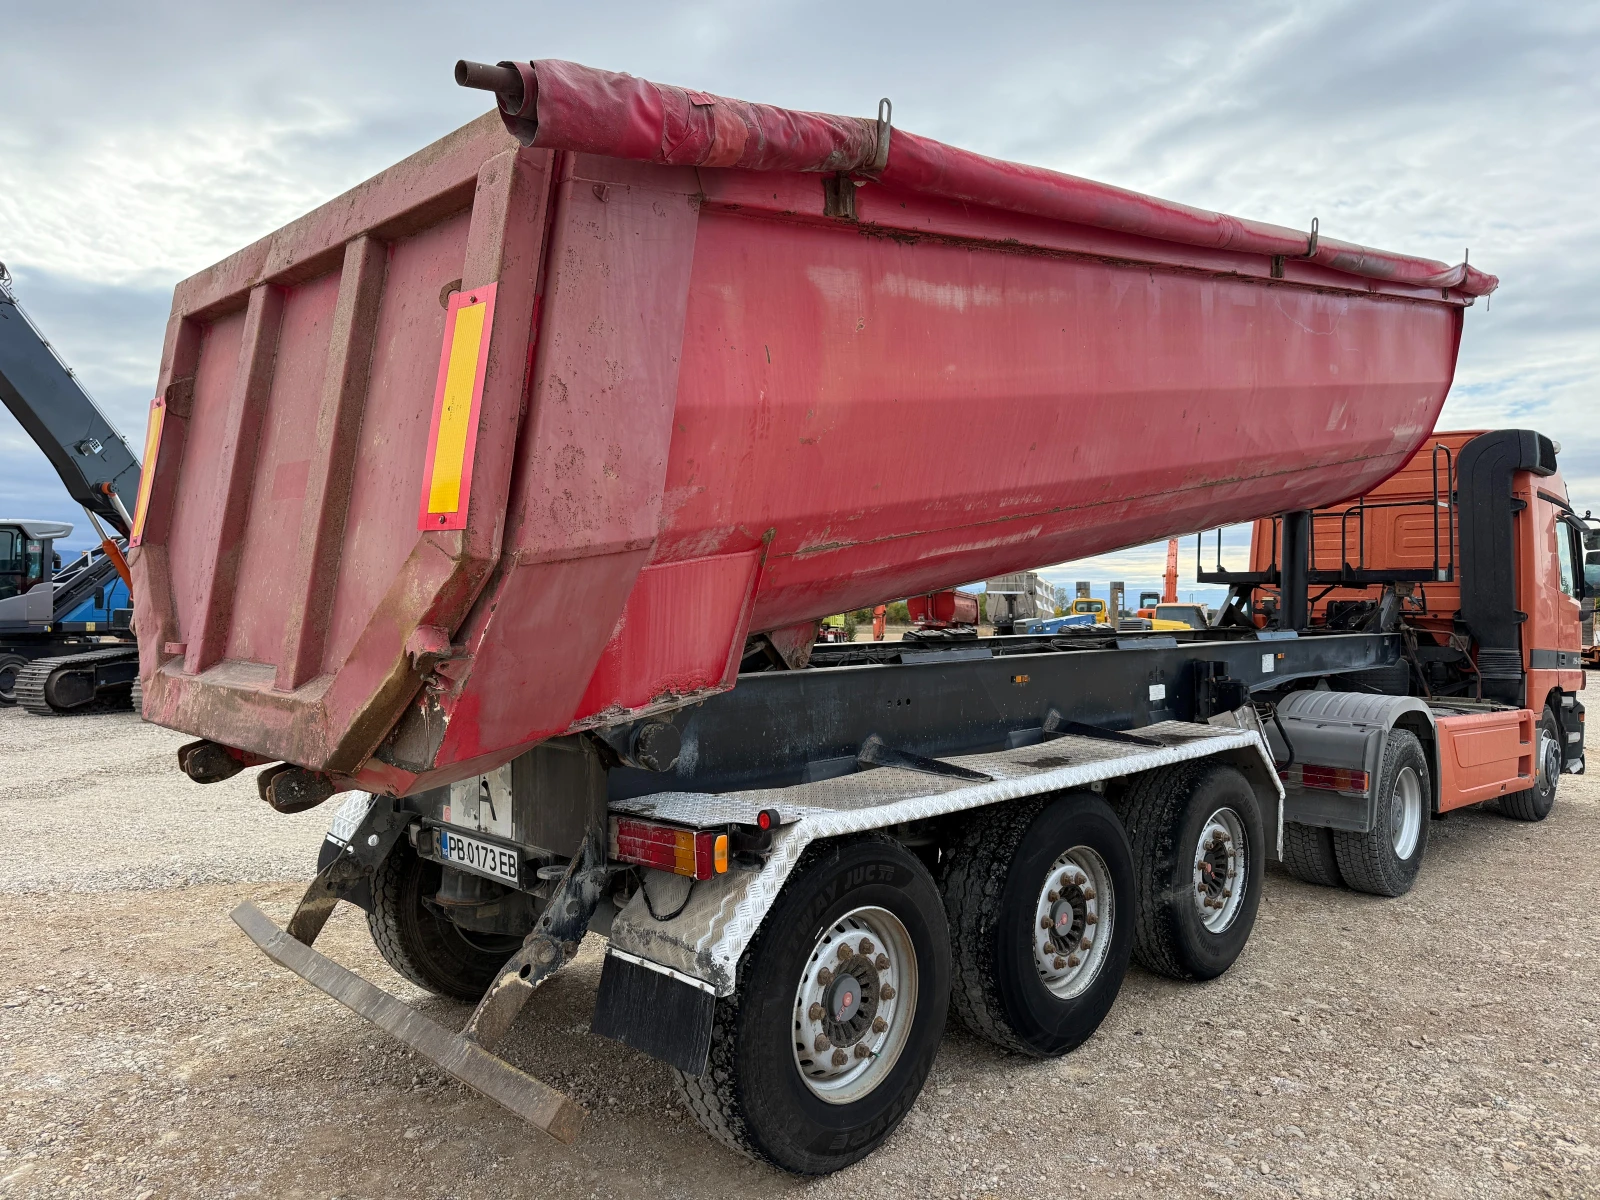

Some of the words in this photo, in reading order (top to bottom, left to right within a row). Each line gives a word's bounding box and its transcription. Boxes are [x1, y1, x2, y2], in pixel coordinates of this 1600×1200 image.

[448, 835, 466, 861] PB
[467, 841, 497, 872] 0173
[498, 850, 517, 879] EB
